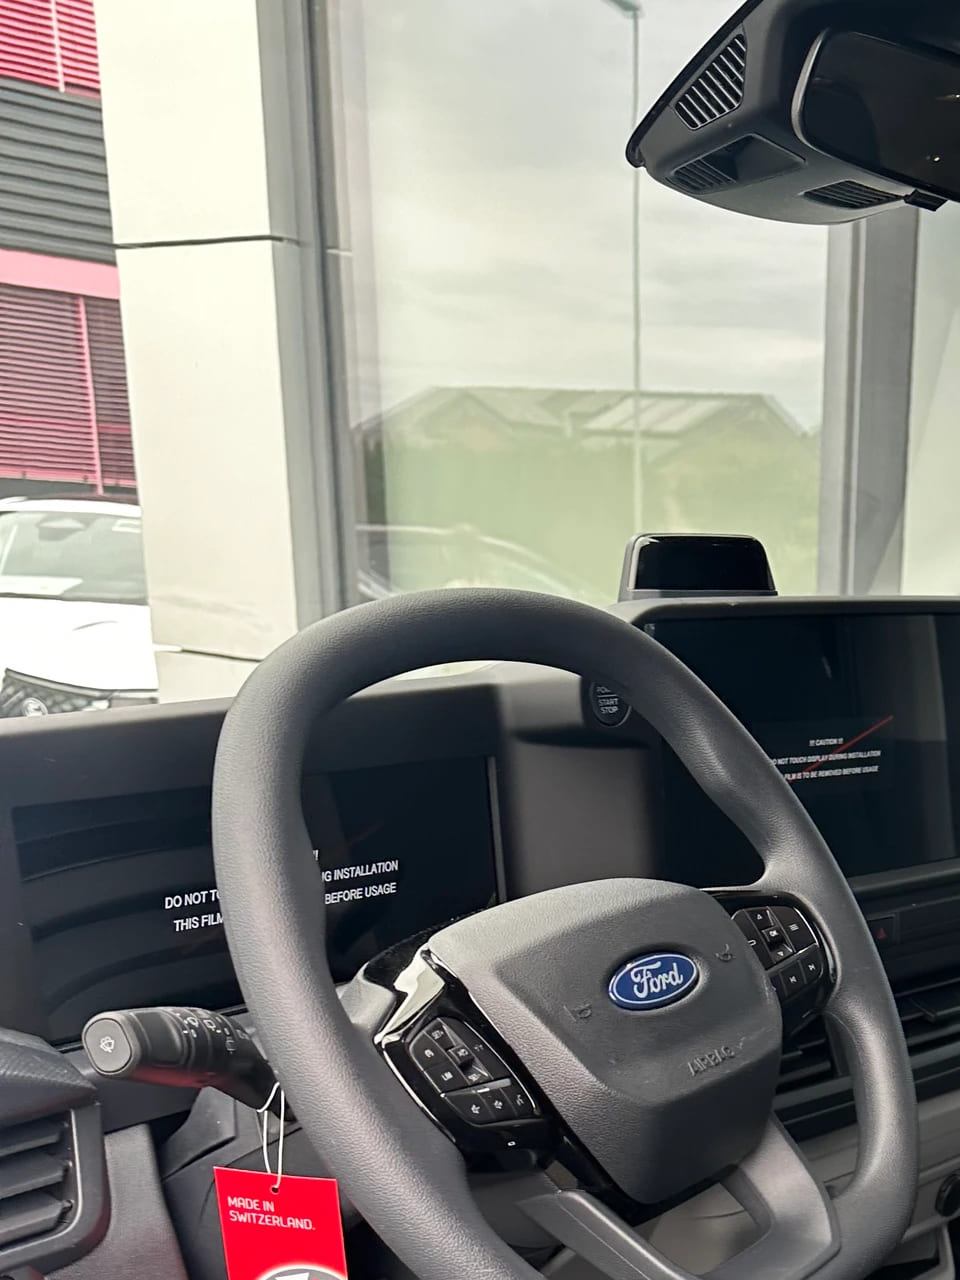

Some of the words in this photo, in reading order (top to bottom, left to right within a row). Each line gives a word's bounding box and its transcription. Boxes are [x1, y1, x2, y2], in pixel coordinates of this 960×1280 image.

[777, 757, 789, 765] NOT
[789, 756, 807, 764] TOUCH
[807, 754, 828, 762] DISPLAY
[828, 753, 847, 761] DURING
[847, 750, 881, 759] INSTALLATION
[818, 768, 842, 777] REMOVED
[842, 766, 861, 775] BEFORE
[333, 859, 399, 881] INSTALLATION
[165, 895, 183, 909] DO
[184, 890, 208, 906] NOT
[324, 887, 363, 905] BEFORE
[364, 882, 397, 898] USAGE
[173, 917, 200, 932] THIS
[630, 961, 684, 998] Ford
[227, 1196, 261, 1211] MADE
[262, 1200, 275, 1212] IN
[229, 1210, 316, 1230] SWITZERLAND.
